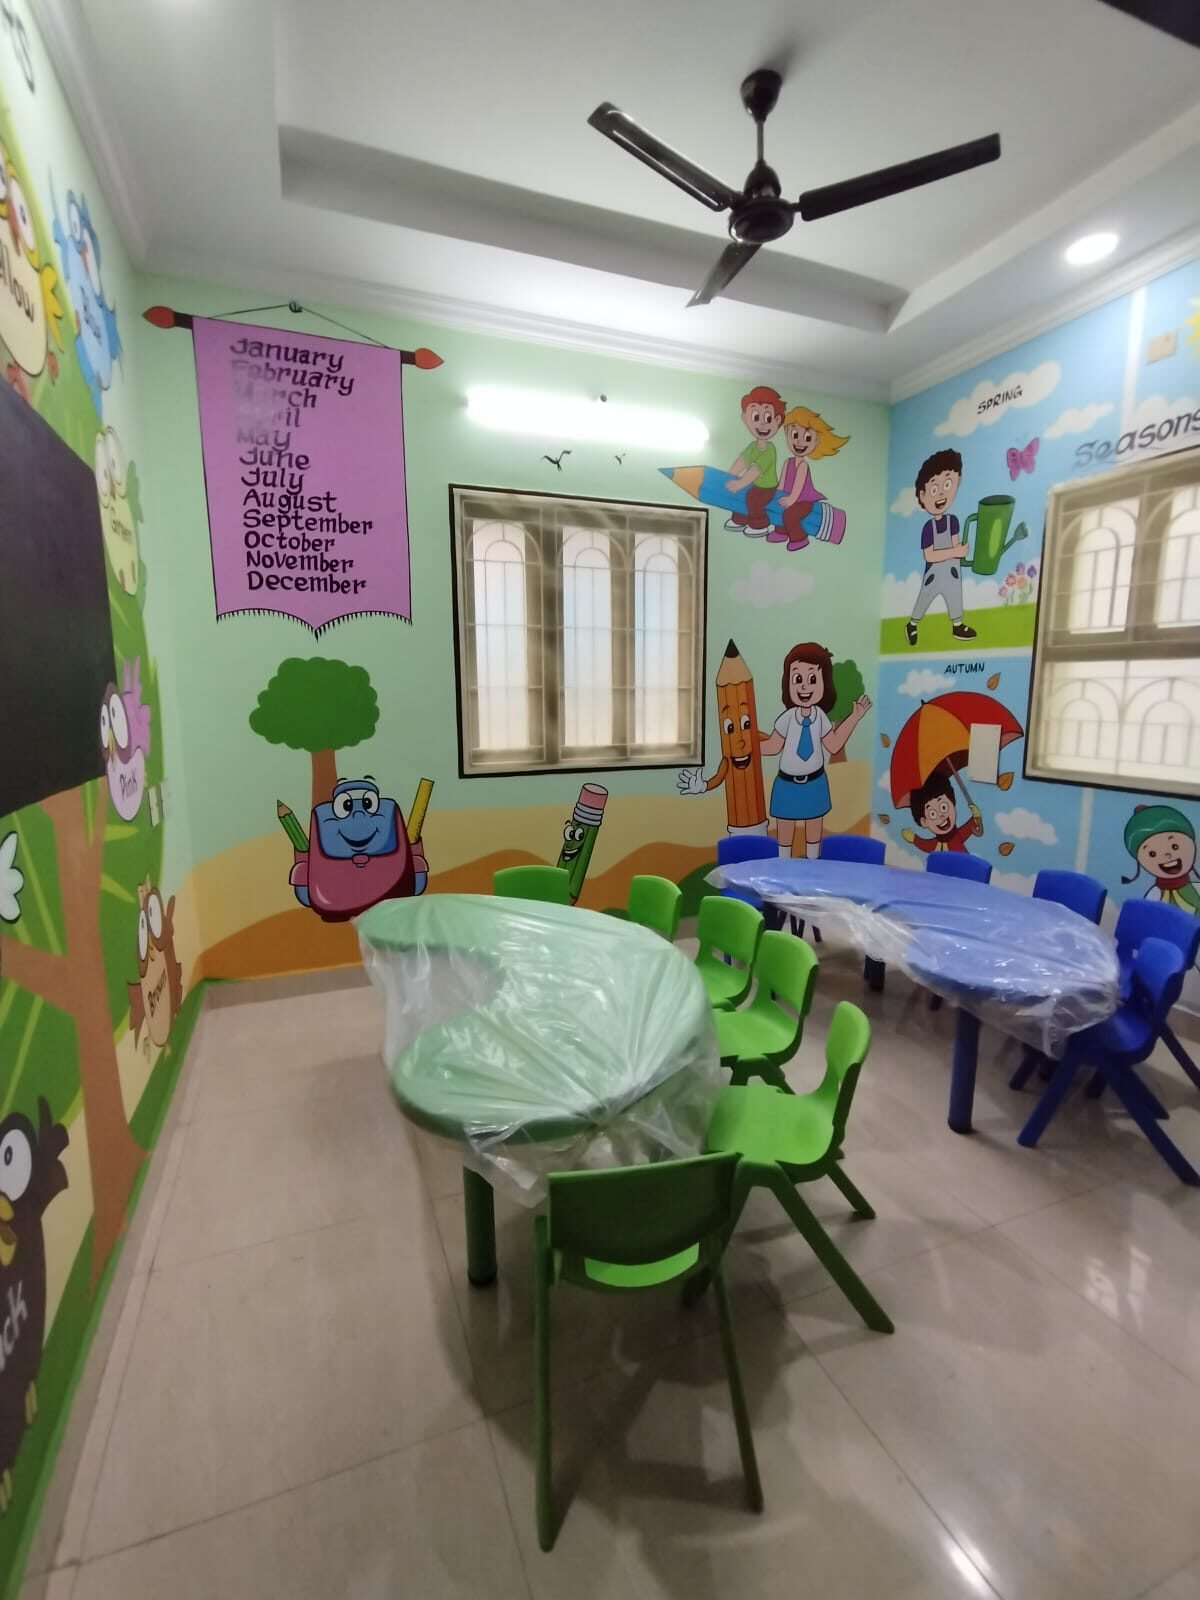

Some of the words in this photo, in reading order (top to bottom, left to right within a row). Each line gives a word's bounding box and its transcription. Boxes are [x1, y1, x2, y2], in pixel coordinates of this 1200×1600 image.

[229, 337, 344, 373] January
[977, 384, 1023, 415] SPRING
[237, 426, 291, 452] May
[239, 447, 311, 470] June
[241, 467, 304, 495] July
[243, 488, 337, 514] August
[243, 509, 373, 535] September
[244, 530, 335, 552] October
[246, 550, 354, 573] November
[247, 570, 366, 594] December
[943, 661, 985, 674] AUTUMN
